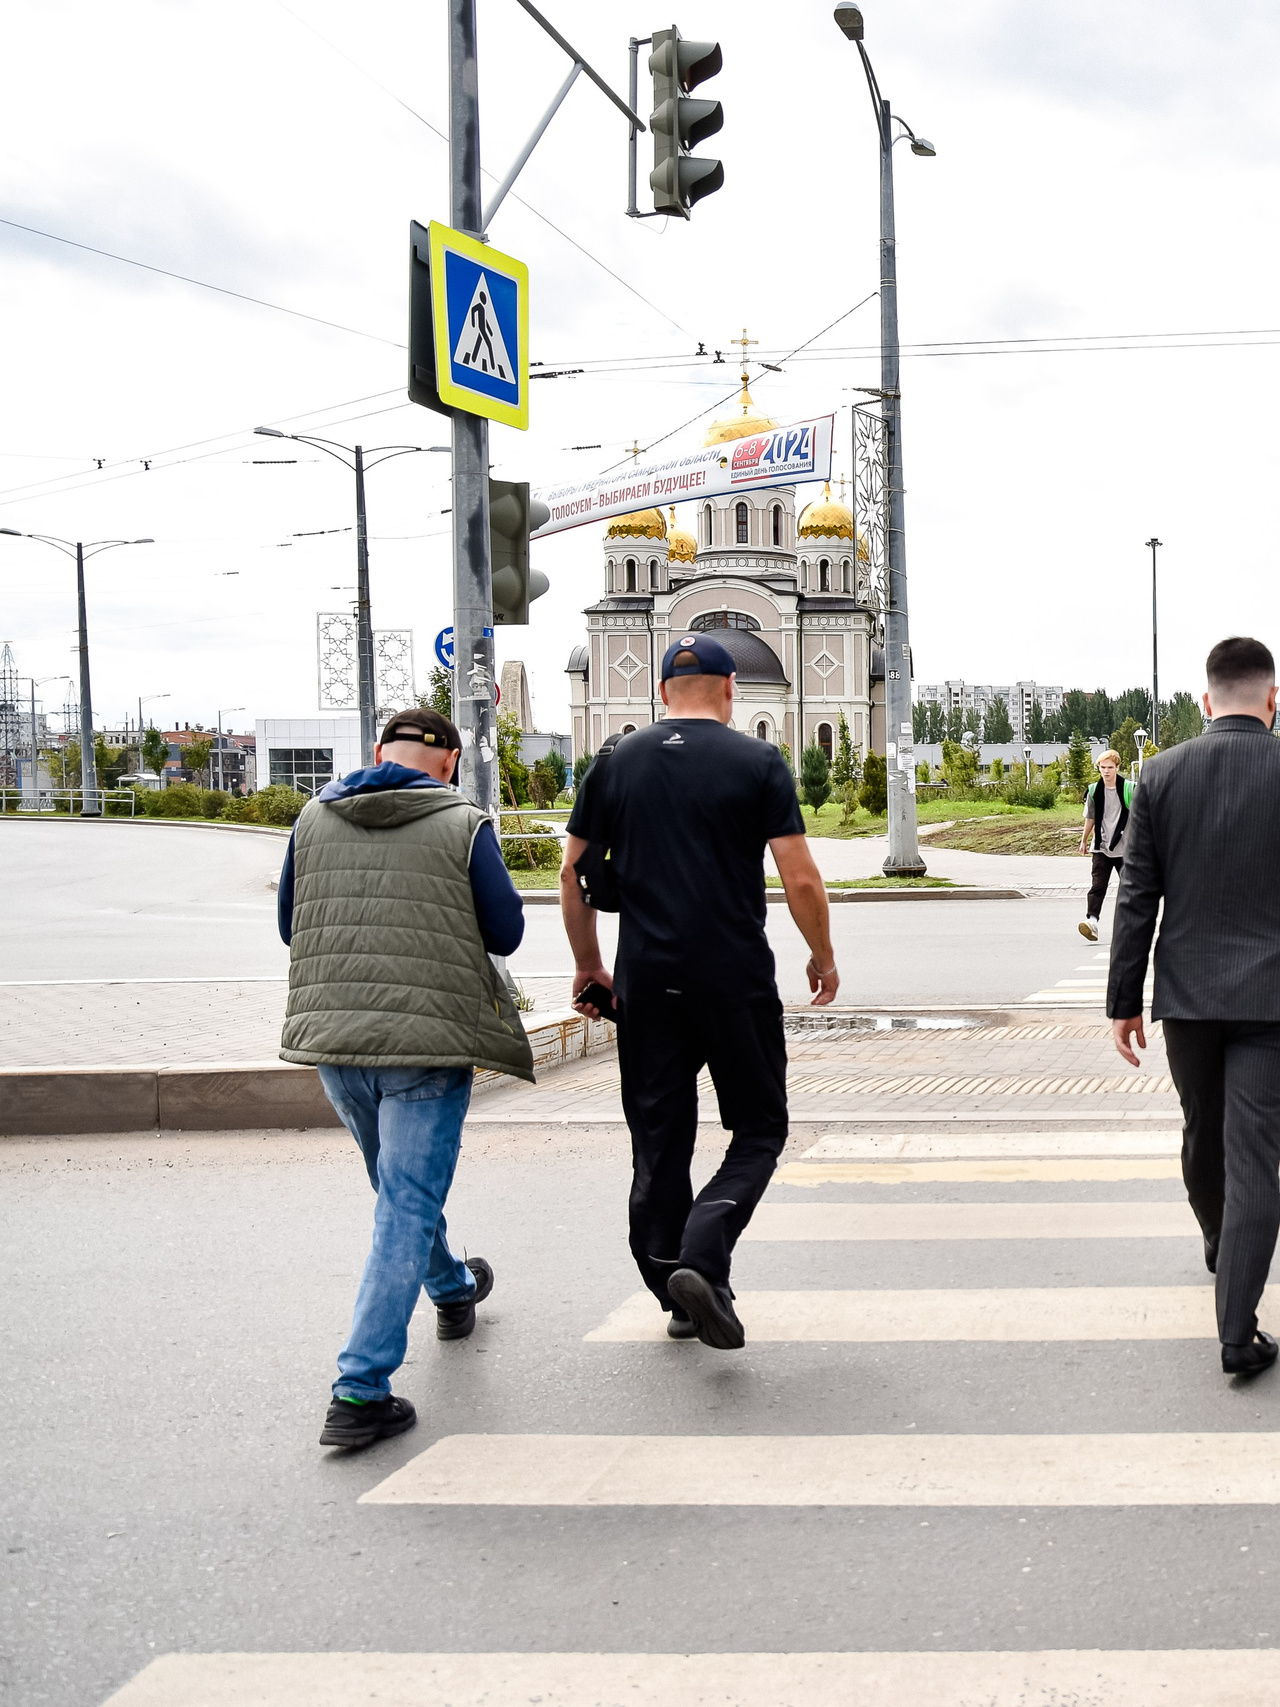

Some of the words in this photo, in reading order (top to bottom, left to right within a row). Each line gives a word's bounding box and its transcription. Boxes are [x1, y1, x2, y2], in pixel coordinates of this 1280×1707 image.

[735, 440, 758, 458] 6-8
[761, 428, 810, 463] 2024
[680, 449, 722, 467] ОБЛАСТИ
[733, 457, 759, 468] СЕНТЯБРЯ
[731, 468, 754, 479] ЕДИНЫЙ
[754, 466, 768, 476] ДЕНЬ
[769, 461, 812, 473] ГОЛОСОВАНИЯ
[654, 470, 706, 495] БУДУЩЕЕ!
